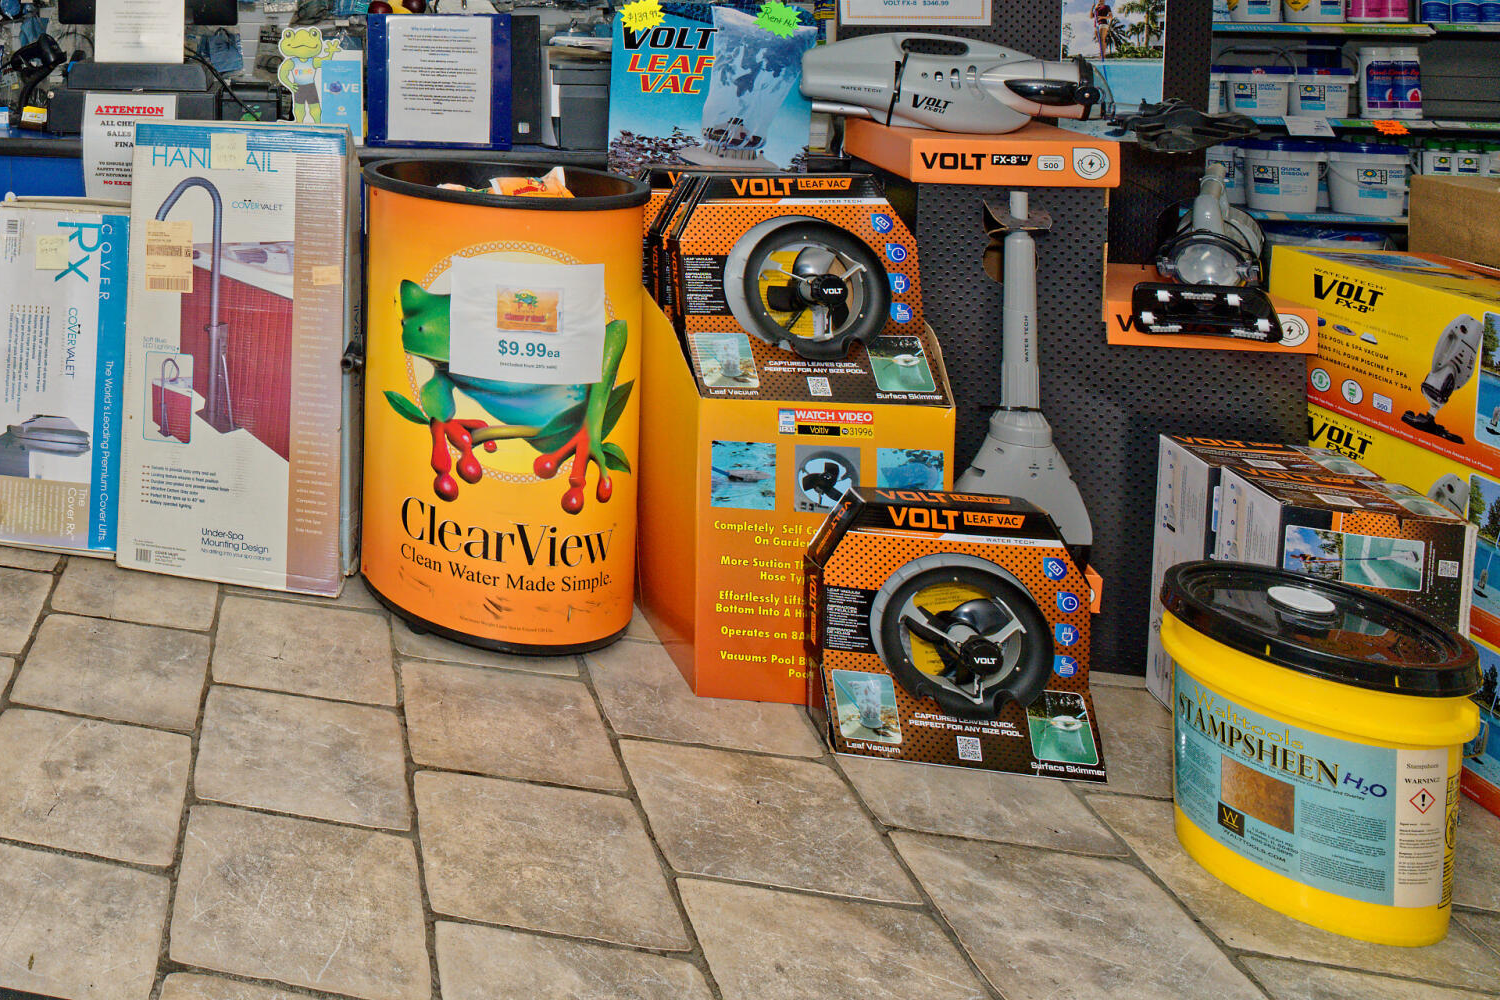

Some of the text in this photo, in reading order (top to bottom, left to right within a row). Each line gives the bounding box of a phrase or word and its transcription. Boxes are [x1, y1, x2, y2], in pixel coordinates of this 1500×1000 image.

[623, 22, 718, 50] VOLT
[627, 54, 717, 74] LEAF
[640, 74, 704, 95] VAC
[95, 105, 164, 116] ATTENTION
[911, 94, 953, 109] VOLT
[152, 146, 279, 173] HANAIL
[920, 152, 986, 170] VOLT
[731, 178, 846, 196] VOLT LEAF VAC
[98, 224, 113, 300] COVER
[1313, 273, 1384, 307] VOLT
[498, 339, 560, 358] $9.99ea
[105, 360, 113, 377] The
[876, 392, 905, 400] Surface
[795, 411, 873, 422] WATCH VIDEO
[101, 412, 111, 448] Leading
[850, 426, 873, 437] 31996
[100, 450, 110, 492] Premium
[99, 494, 108, 522] Cover
[201, 528, 244, 540] Under-Spa
[401, 495, 615, 568] ClearView
[714, 520, 803, 535] Completely Self
[201, 537, 269, 553] Mounting Design
[400, 543, 612, 593] Clean Water Made Simple.
[720, 556, 792, 570] More Suction
[719, 590, 780, 606] Effortlessly
[1192, 686, 1304, 750] Walttools
[1178, 692, 1339, 788] STAMPSHEEN
